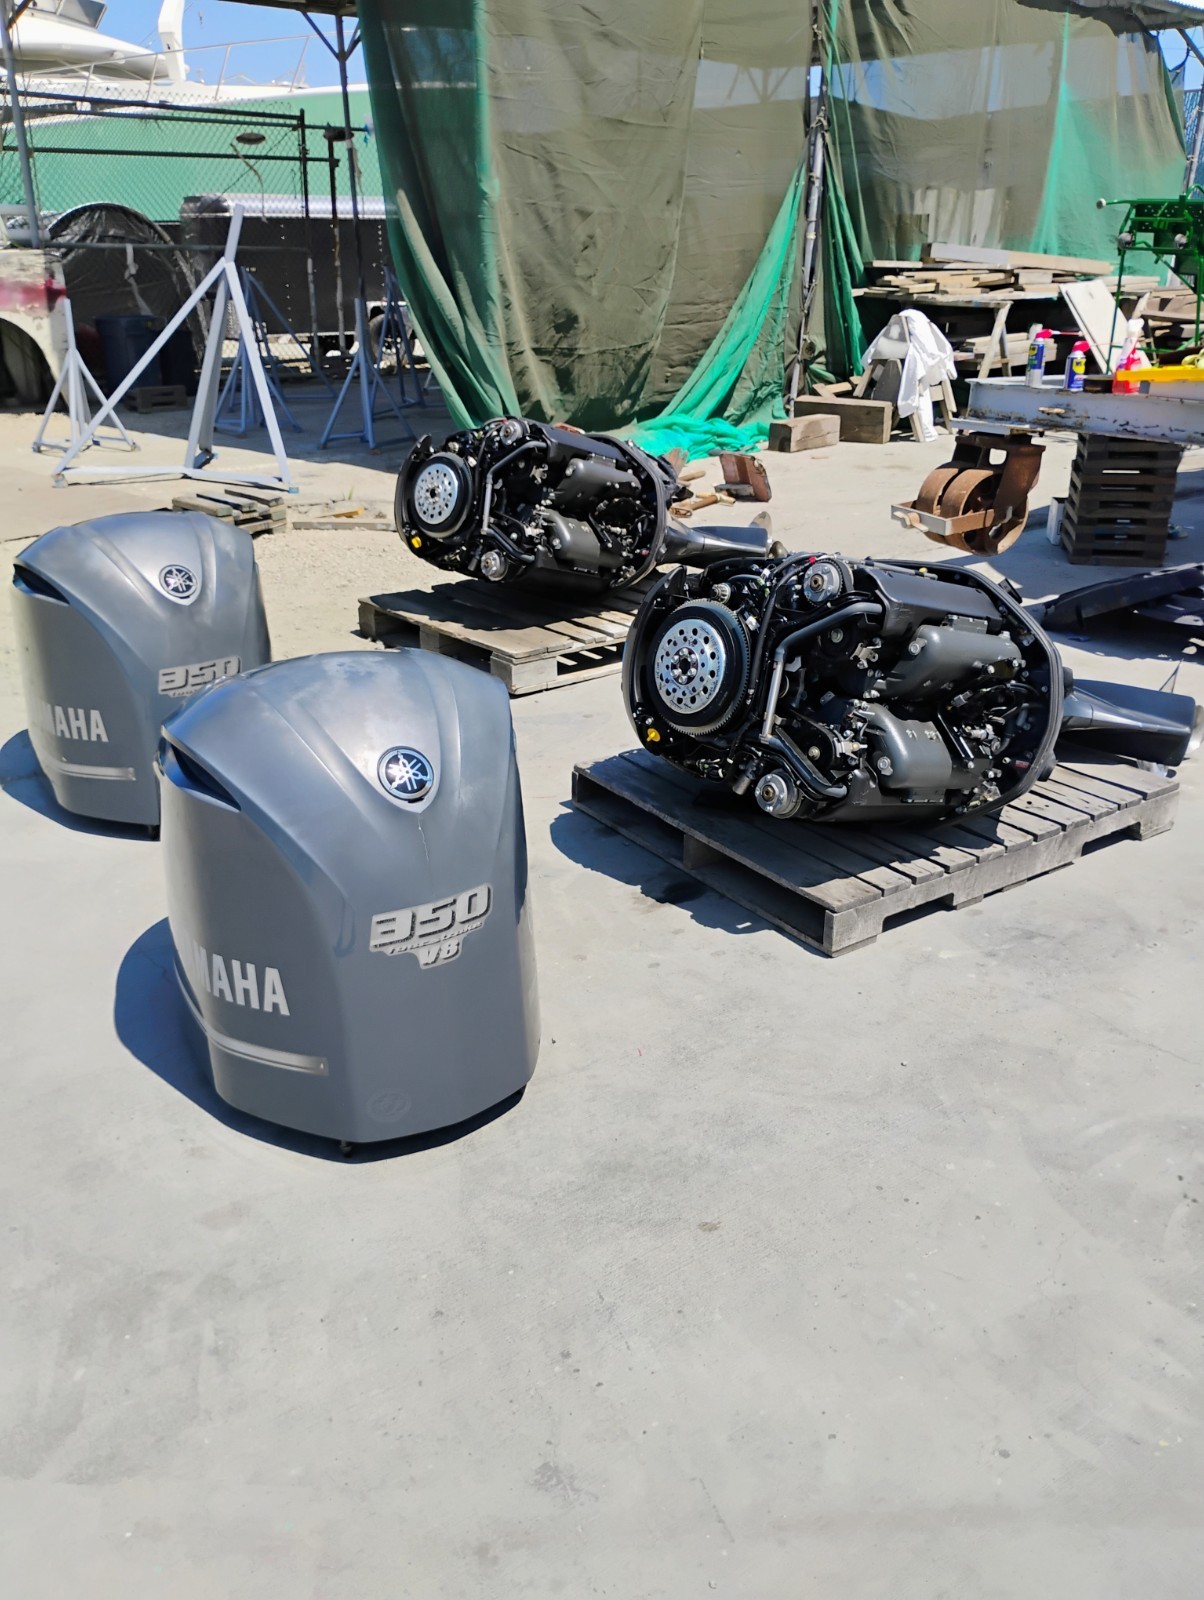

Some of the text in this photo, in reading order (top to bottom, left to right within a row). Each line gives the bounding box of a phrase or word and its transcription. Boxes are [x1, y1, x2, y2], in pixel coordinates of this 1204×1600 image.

[372, 884, 492, 951] 350
[188, 939, 290, 1016] MAHA
[420, 939, 461, 967] V8
